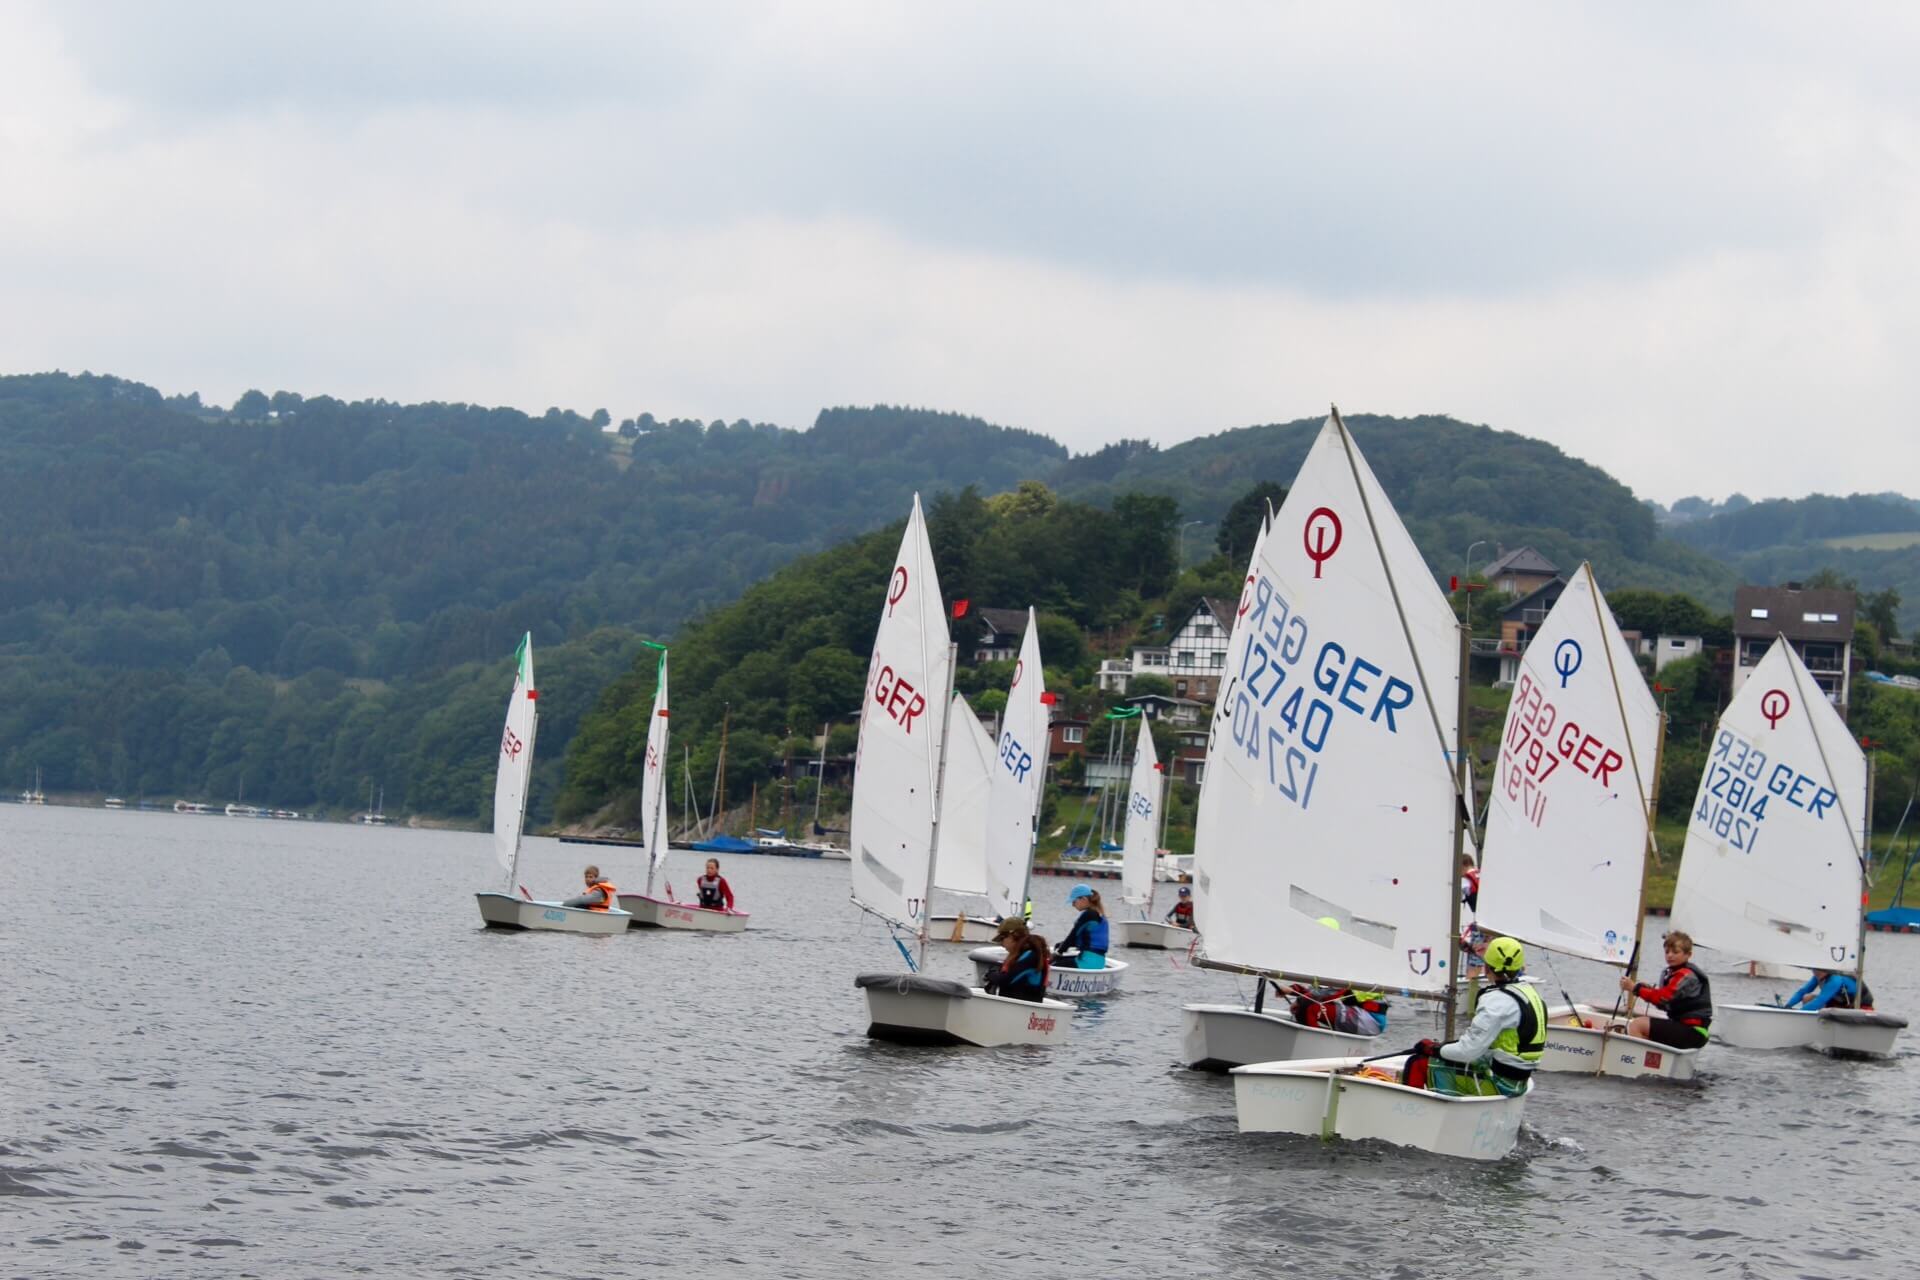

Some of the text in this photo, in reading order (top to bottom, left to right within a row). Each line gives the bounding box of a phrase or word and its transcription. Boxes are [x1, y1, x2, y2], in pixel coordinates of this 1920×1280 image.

[875, 665, 926, 734] GER
[1241, 633, 1334, 753] 12740
[1313, 641, 1414, 733] GER
[1001, 731, 1031, 783] GER
[1506, 711, 1560, 783] 11797
[1557, 722, 1623, 788] GER
[1705, 761, 1769, 822] 12814
[1767, 763, 1838, 820] GER
